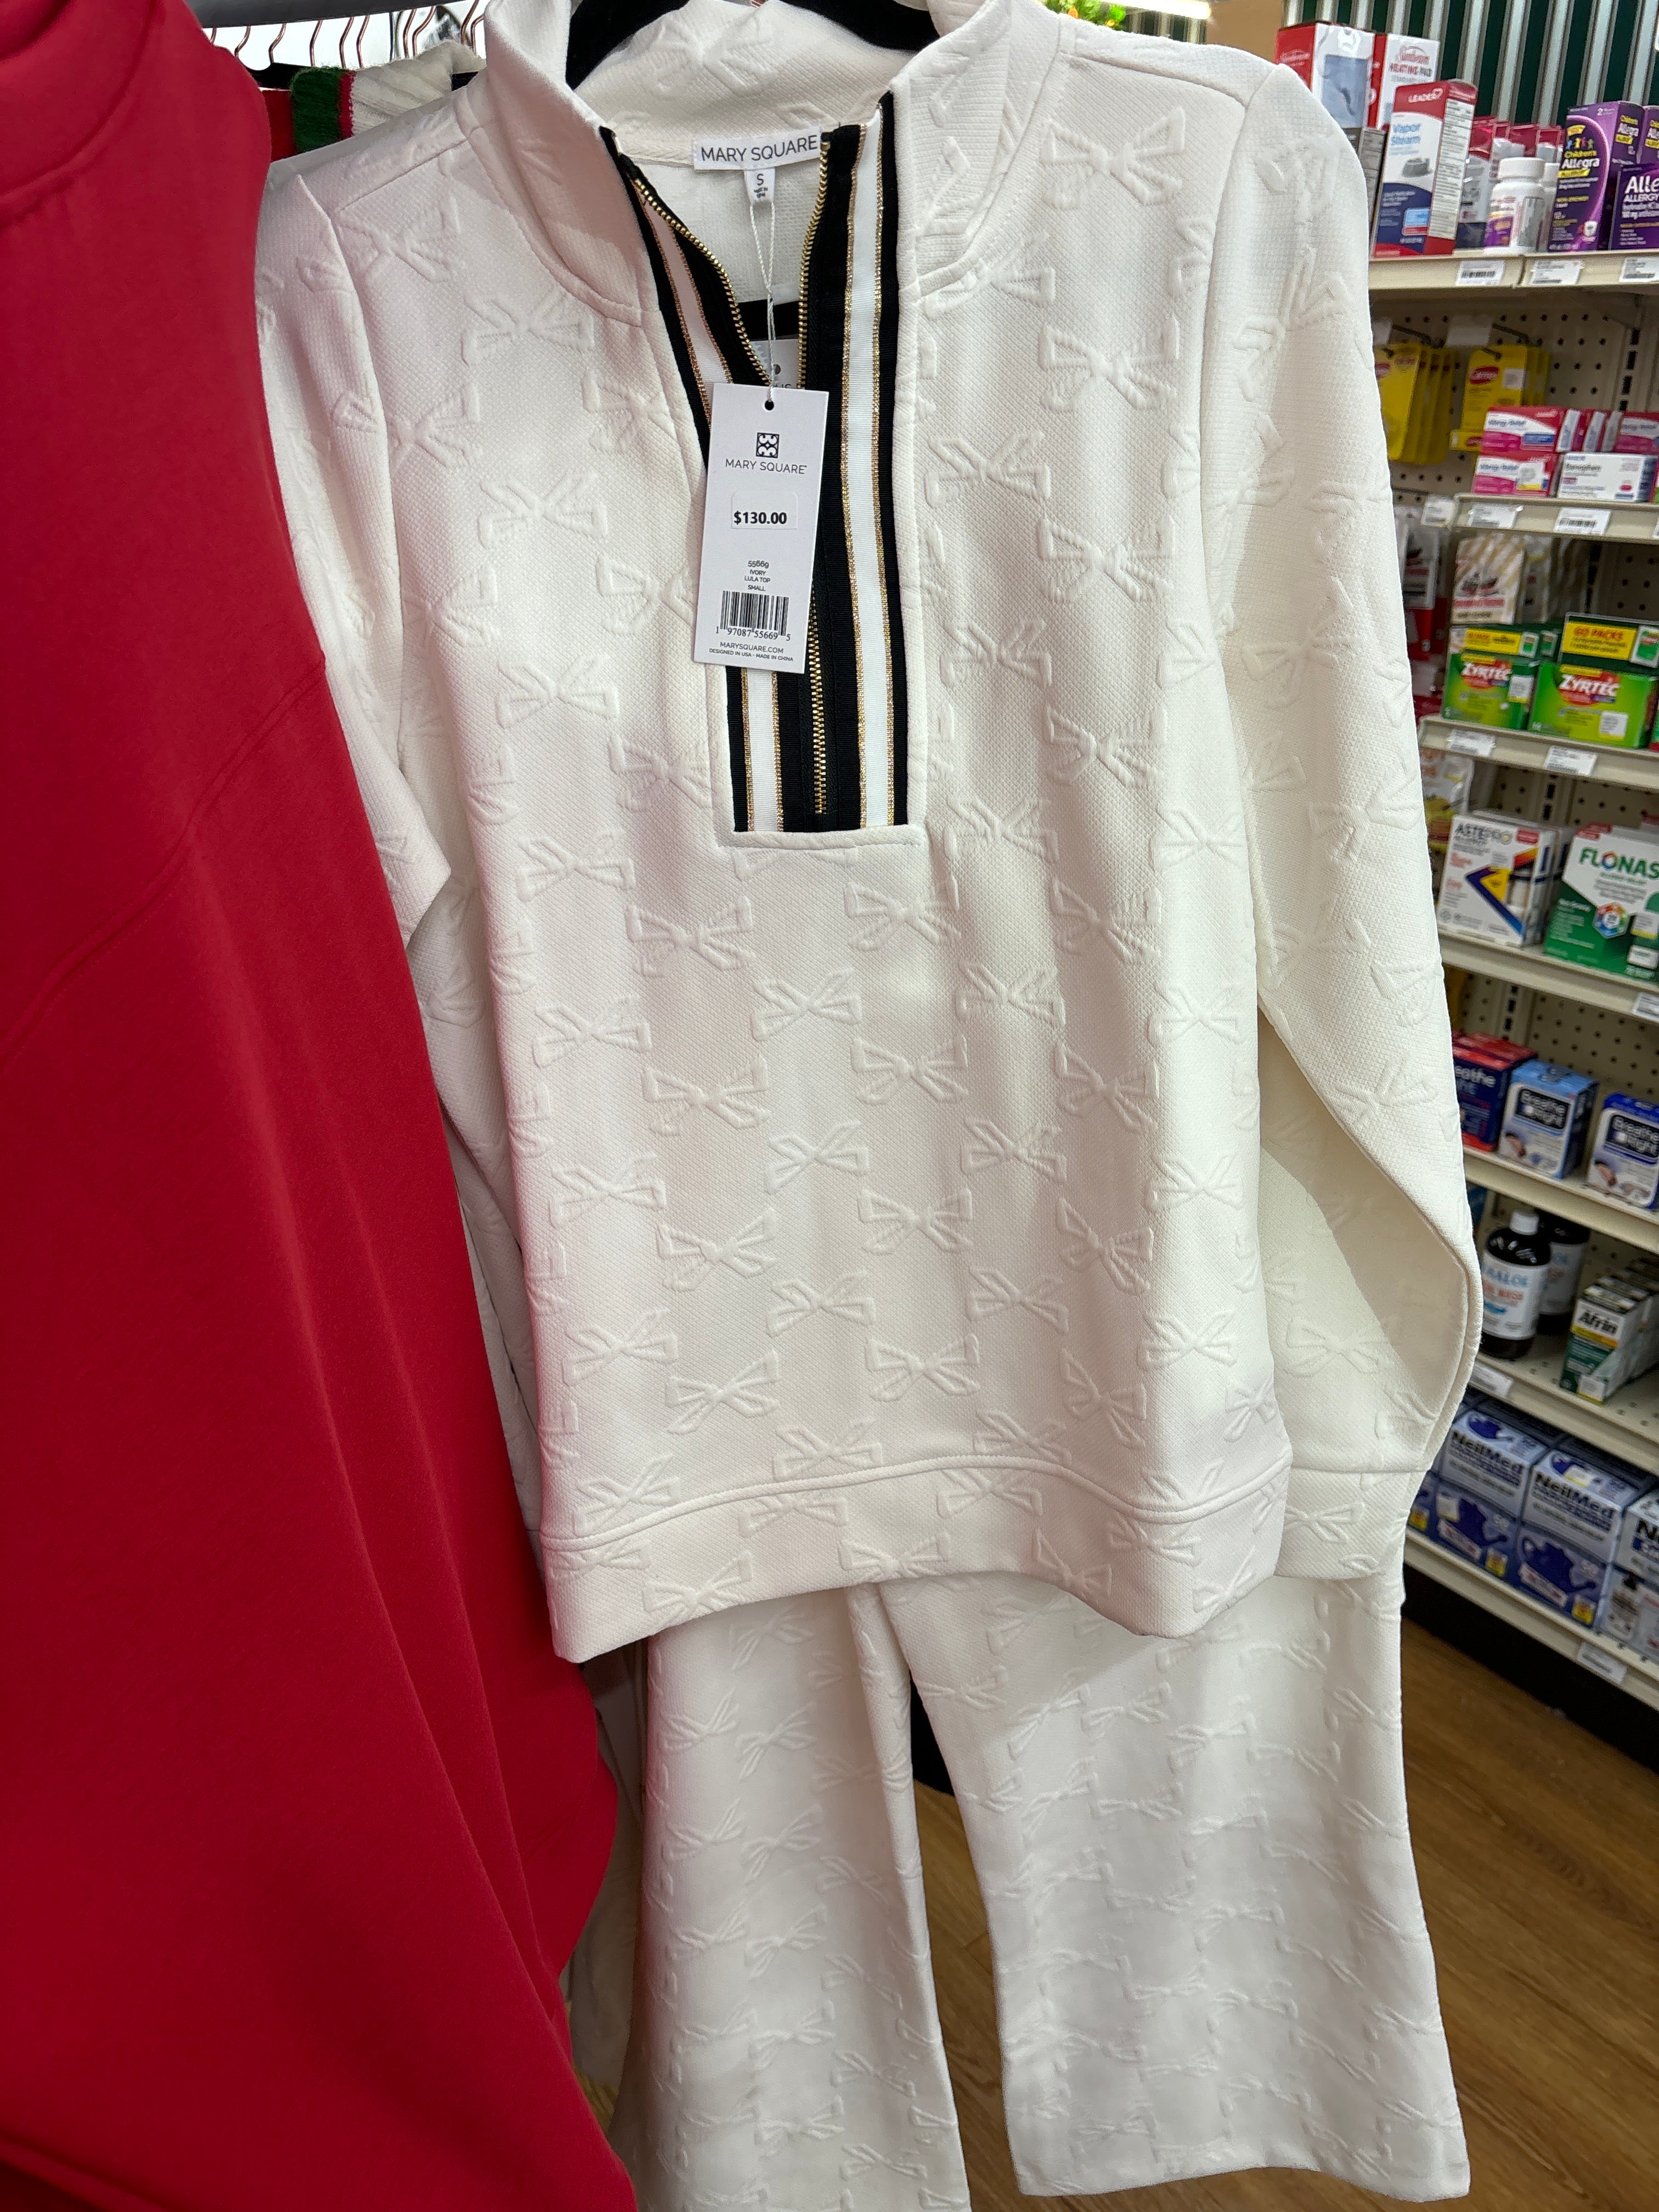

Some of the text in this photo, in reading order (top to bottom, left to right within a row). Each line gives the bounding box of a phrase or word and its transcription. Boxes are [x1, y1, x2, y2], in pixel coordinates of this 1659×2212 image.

[701, 134, 818, 162] MARY SQUARE
[1561, 157, 1600, 170] Allegra
[757, 173, 764, 186] S
[725, 459, 806, 475] MARY SQUARE
[733, 510, 787, 525] $130.00
[747, 560, 769, 569] 55669
[715, 626, 719, 634] 1
[727, 627, 752, 637] 97087
[754, 630, 778, 640] 55669
[720, 641, 784, 654] MARYSQUARE.COM
[1461, 661, 1513, 681] ZYRTEC
[1559, 674, 1621, 697] ZYRTEC
[1454, 1065, 1497, 1088] eathe
[1579, 1311, 1618, 1334] Afrin
[1452, 1431, 1525, 1475] NeilMed
[1536, 1473, 1616, 1520] NeilMed
